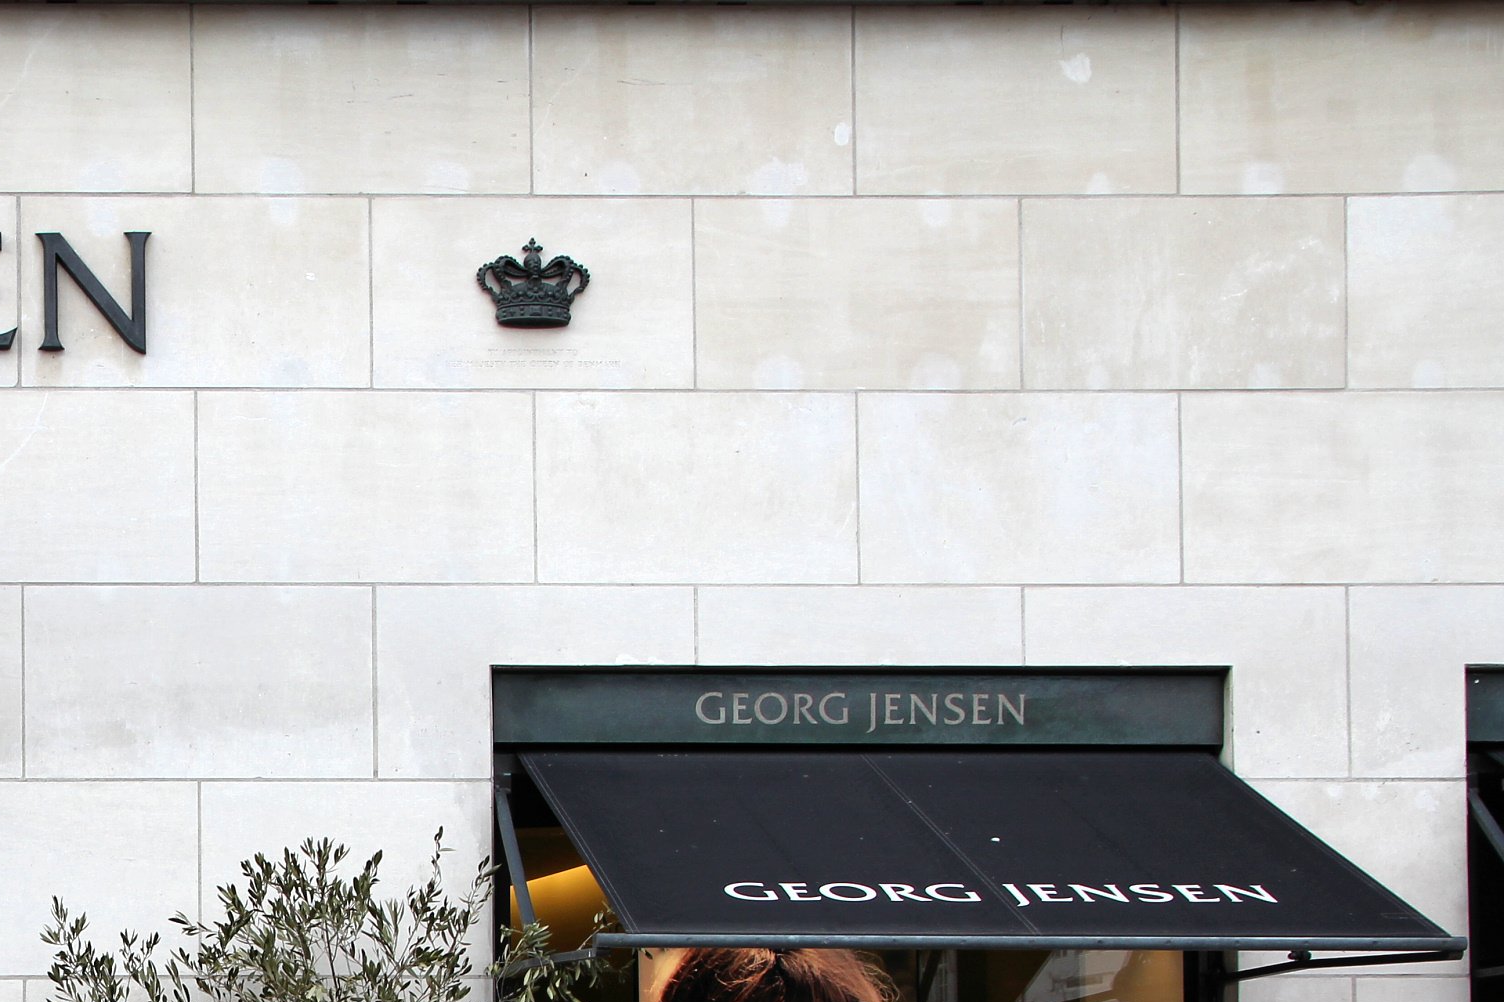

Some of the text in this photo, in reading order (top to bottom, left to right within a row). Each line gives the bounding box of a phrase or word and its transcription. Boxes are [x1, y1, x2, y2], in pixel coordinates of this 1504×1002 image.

[695, 691, 1026, 733] GEORG JENSEN
[723, 881, 1278, 907] GEORG JENSEN
